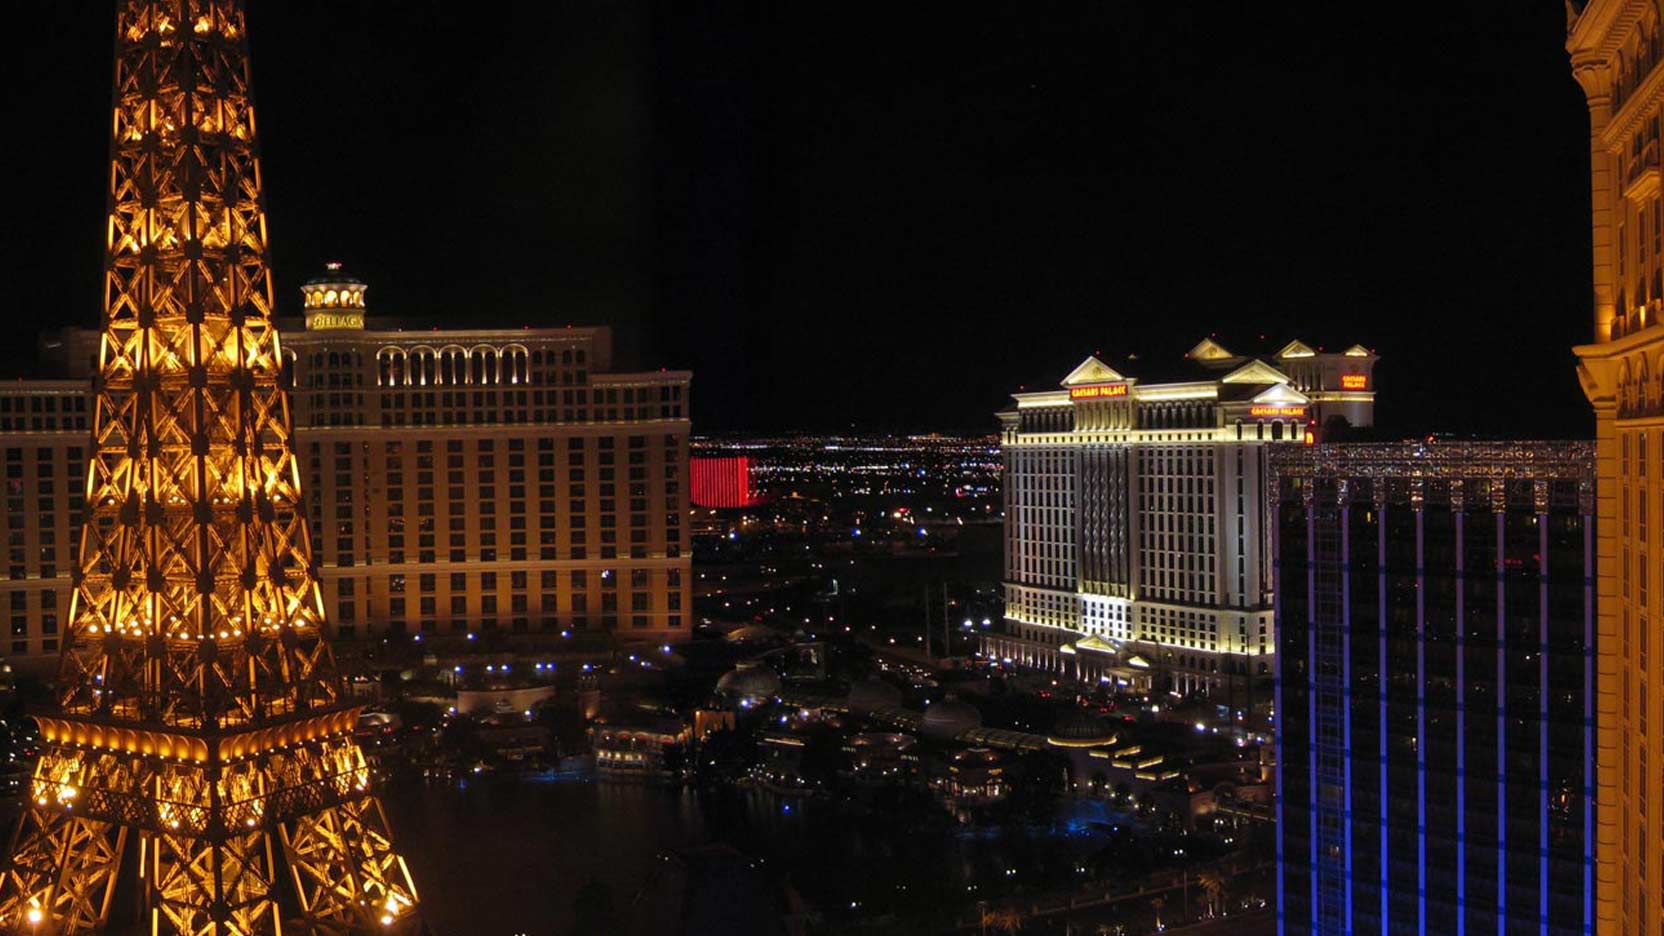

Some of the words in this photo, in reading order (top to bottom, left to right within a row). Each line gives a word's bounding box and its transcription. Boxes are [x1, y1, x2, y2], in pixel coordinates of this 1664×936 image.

[313, 313, 364, 330] BELLAG
[1071, 387, 1099, 398] CAESARS
[1100, 385, 1126, 396] PALACE
[1251, 407, 1279, 416] CAESARS
[1281, 407, 1304, 416] PALACE
